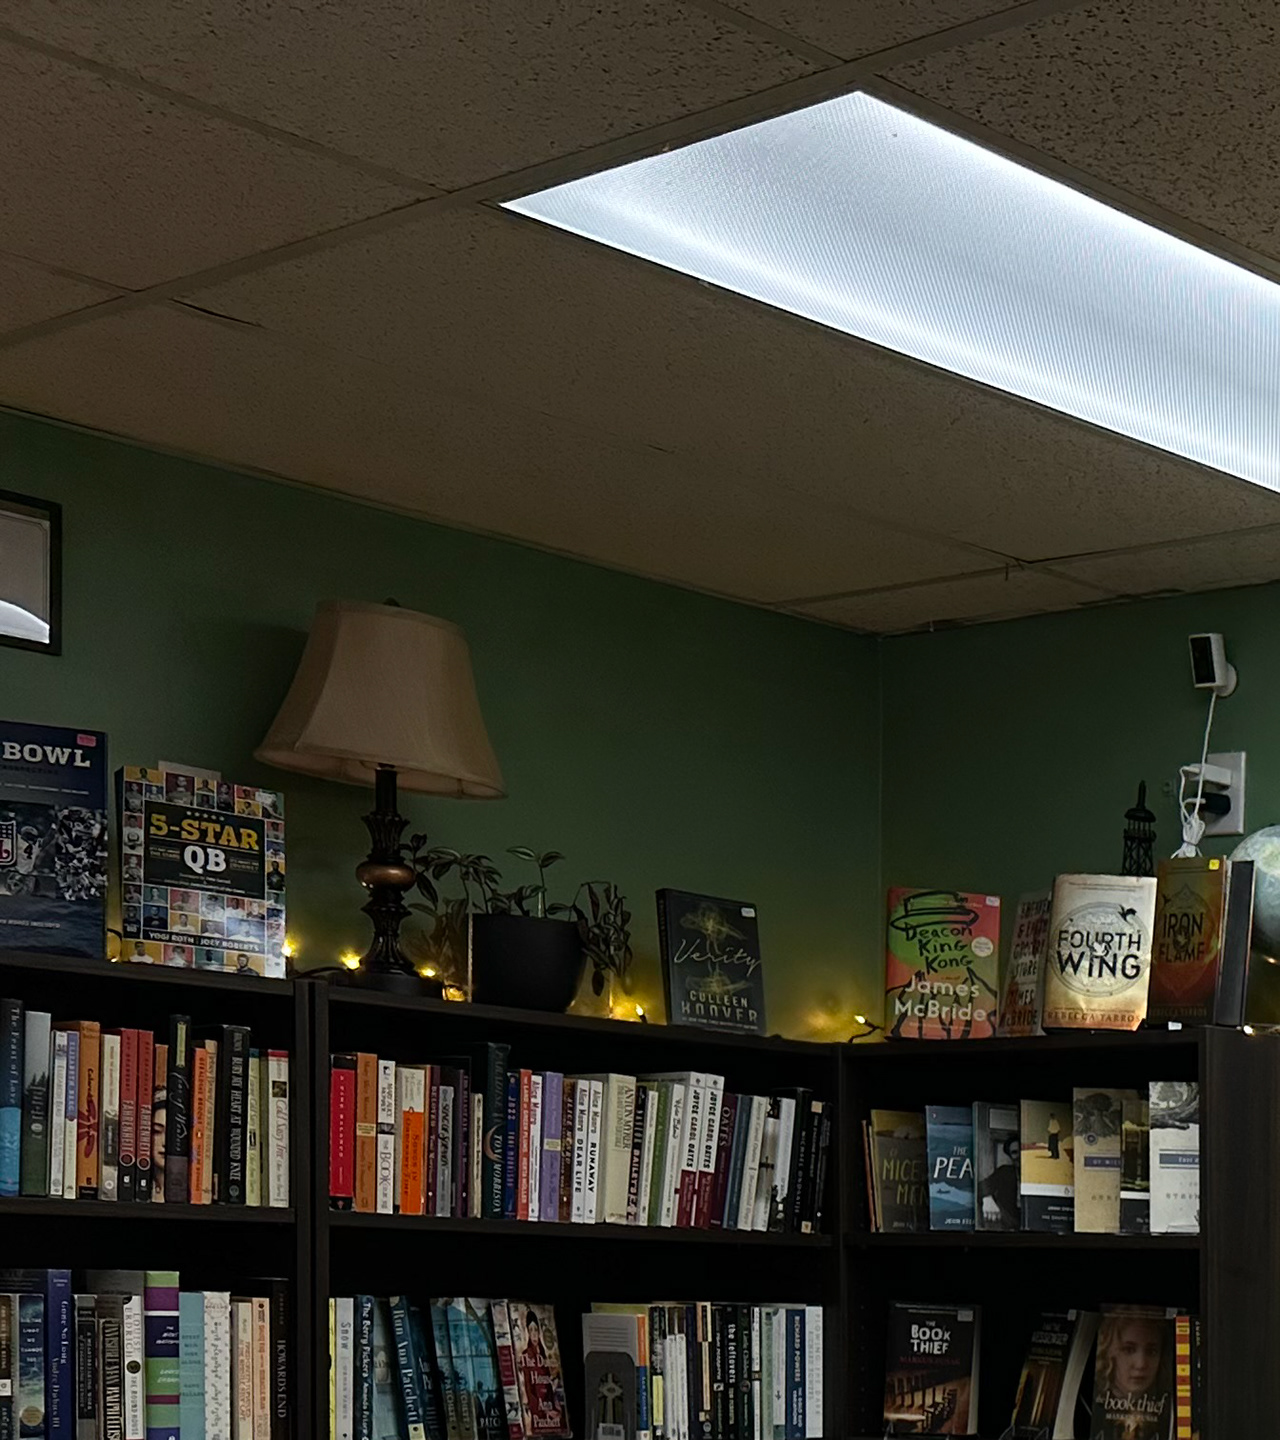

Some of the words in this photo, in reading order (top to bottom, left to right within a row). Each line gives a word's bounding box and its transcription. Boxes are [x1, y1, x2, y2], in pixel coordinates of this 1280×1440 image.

[2, 741, 91, 768] BOWL
[150, 813, 260, 850] 5-STAR
[183, 846, 227, 874] QB
[904, 922, 973, 941] Deacon
[1163, 912, 1204, 938] IRON
[149, 931, 171, 943] YOGI
[172, 934, 195, 945] ROTH
[200, 936, 221, 947] JOEY
[918, 939, 968, 957] King
[1057, 930, 1141, 951] FOURTH
[674, 939, 761, 977] Verity
[1057, 949, 1141, 979] WING
[1159, 943, 1205, 963] FLAME
[925, 957, 973, 975] Kong
[903, 975, 980, 999] James
[9, 1007, 19, 1027] The
[894, 999, 987, 1021] McBride
[9, 1031, 18, 1060] Feast
[8, 1079, 17, 1104] Love
[577, 1088, 587, 1106] Alice
[707, 1091, 717, 1117] JOYCE
[121, 1100, 134, 1152] FAHRENHEIT
[576, 1108, 585, 1132] Munro
[705, 1118, 715, 1142] CAROL
[491, 1134, 503, 1159] TONI
[574, 1138, 582, 1167] DEAR
[702, 1145, 711, 1169] OATES
[587, 1142, 595, 1193] RUNAWAY
[882, 1158, 919, 1181] MICE
[491, 1162, 502, 1213] MORRISON
[574, 1171, 582, 1193] LIFE
[727, 1323, 735, 1339] the
[910, 1323, 951, 1341] BOOK
[910, 1339, 950, 1356] THIEF
[275, 1340, 286, 1392] HOWARDS
[727, 1342, 735, 1384] leftovers
[276, 1393, 286, 1418] END
